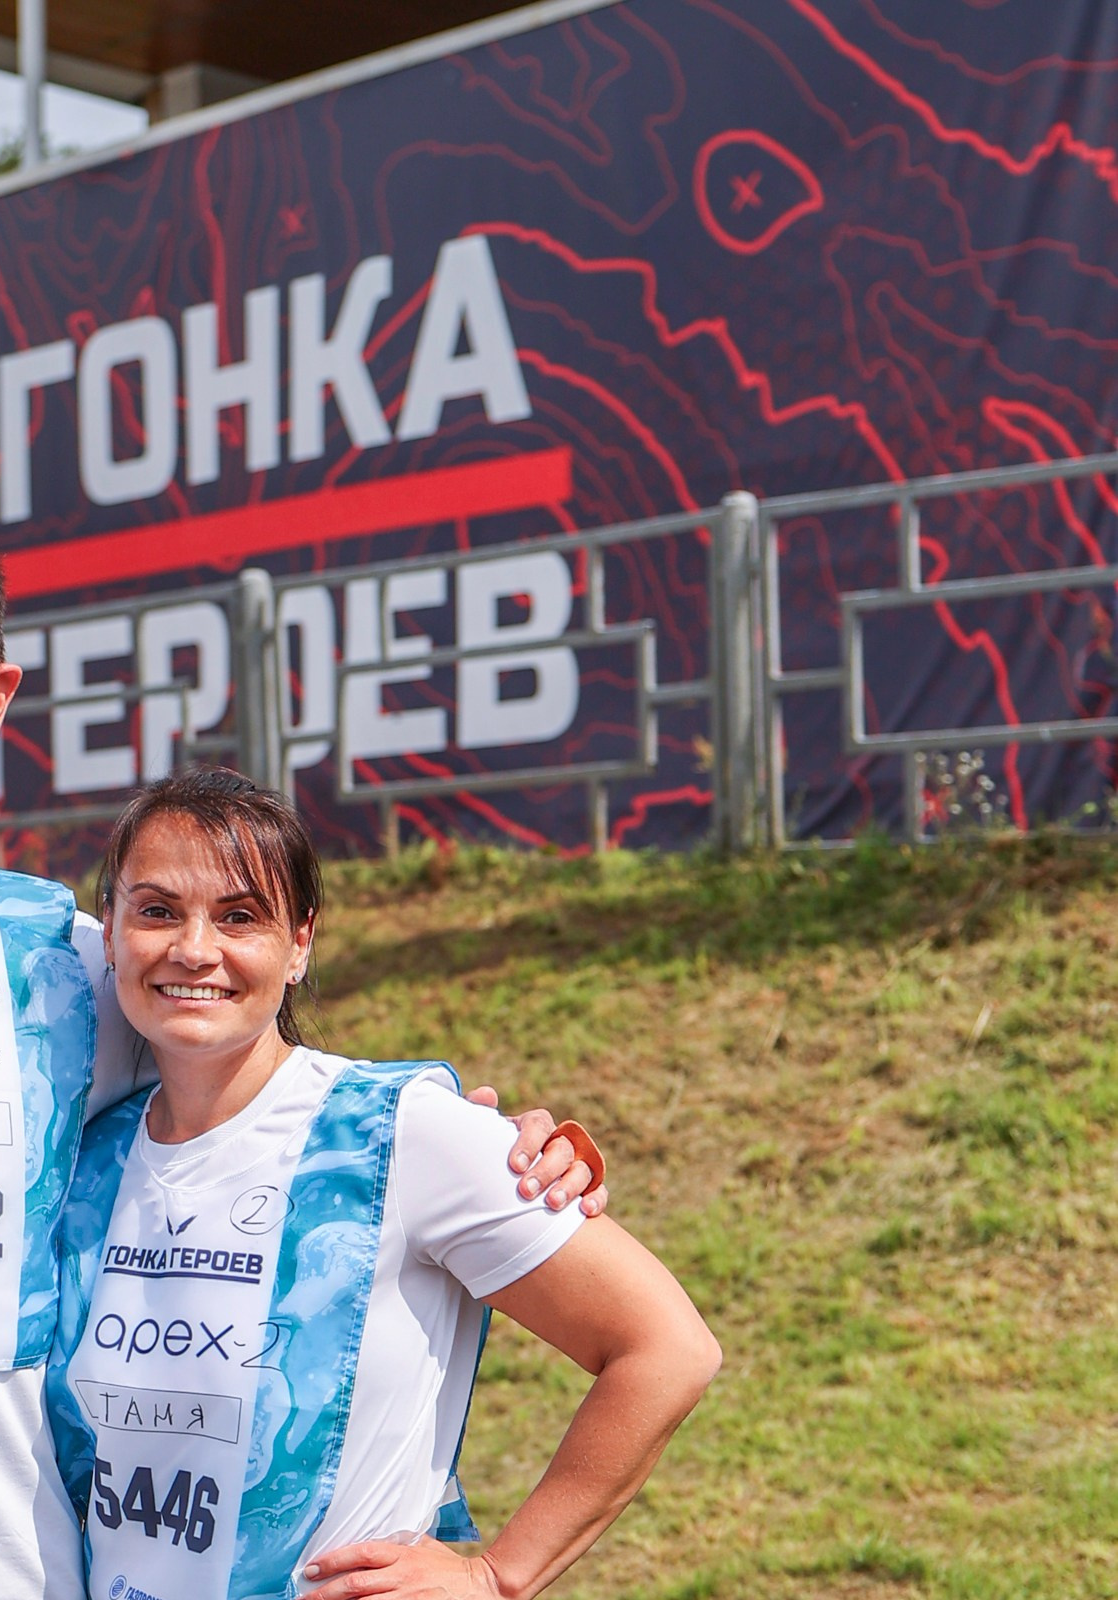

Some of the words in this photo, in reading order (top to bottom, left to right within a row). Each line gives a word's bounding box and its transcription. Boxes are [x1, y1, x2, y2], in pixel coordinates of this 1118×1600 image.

[240, 1195, 268, 1226] 2
[105, 1245, 167, 1270] ГОНКА
[169, 1247, 264, 1275] ГЕРОЕВ
[94, 1457, 220, 1554] 5446
